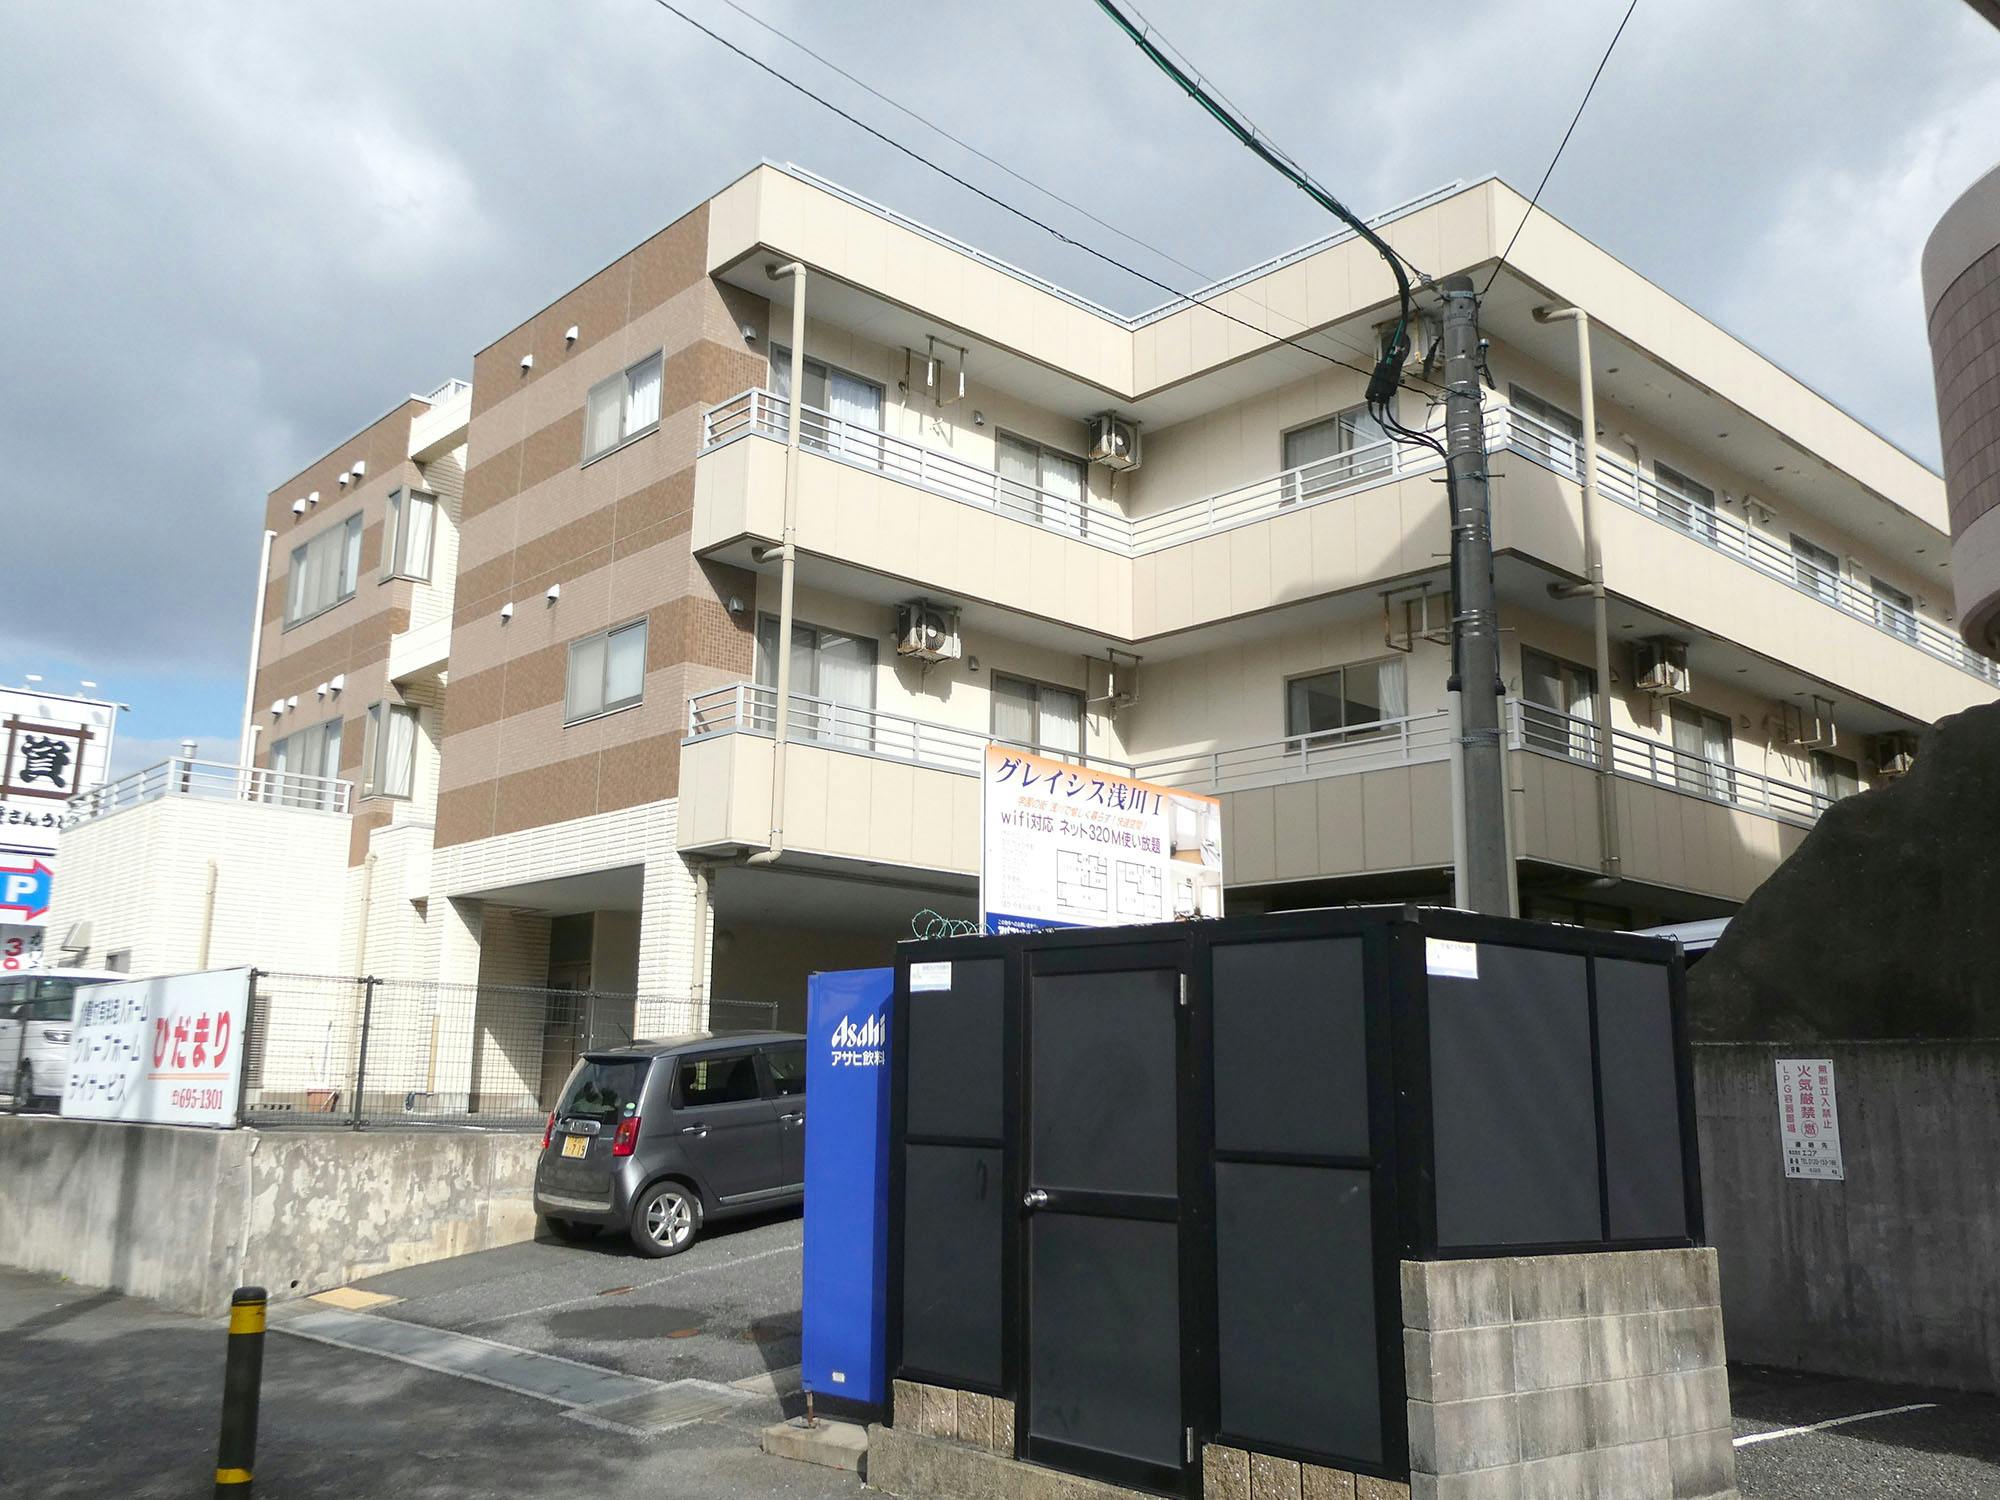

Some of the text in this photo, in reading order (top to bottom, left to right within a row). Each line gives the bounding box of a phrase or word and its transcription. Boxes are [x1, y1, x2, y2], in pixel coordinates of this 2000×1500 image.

[20, 734, 71, 788] 資
[1001, 810, 1054, 833] wifi対応
[5, 875, 38, 902] P
[154, 1010, 231, 1069] ひだまり
[831, 1013, 886, 1048] Asahi
[831, 1050, 885, 1066] アサヒ飲料
[179, 1088, 223, 1110] 695-1301
[1797, 1065, 1816, 1119] 火気厳禁
